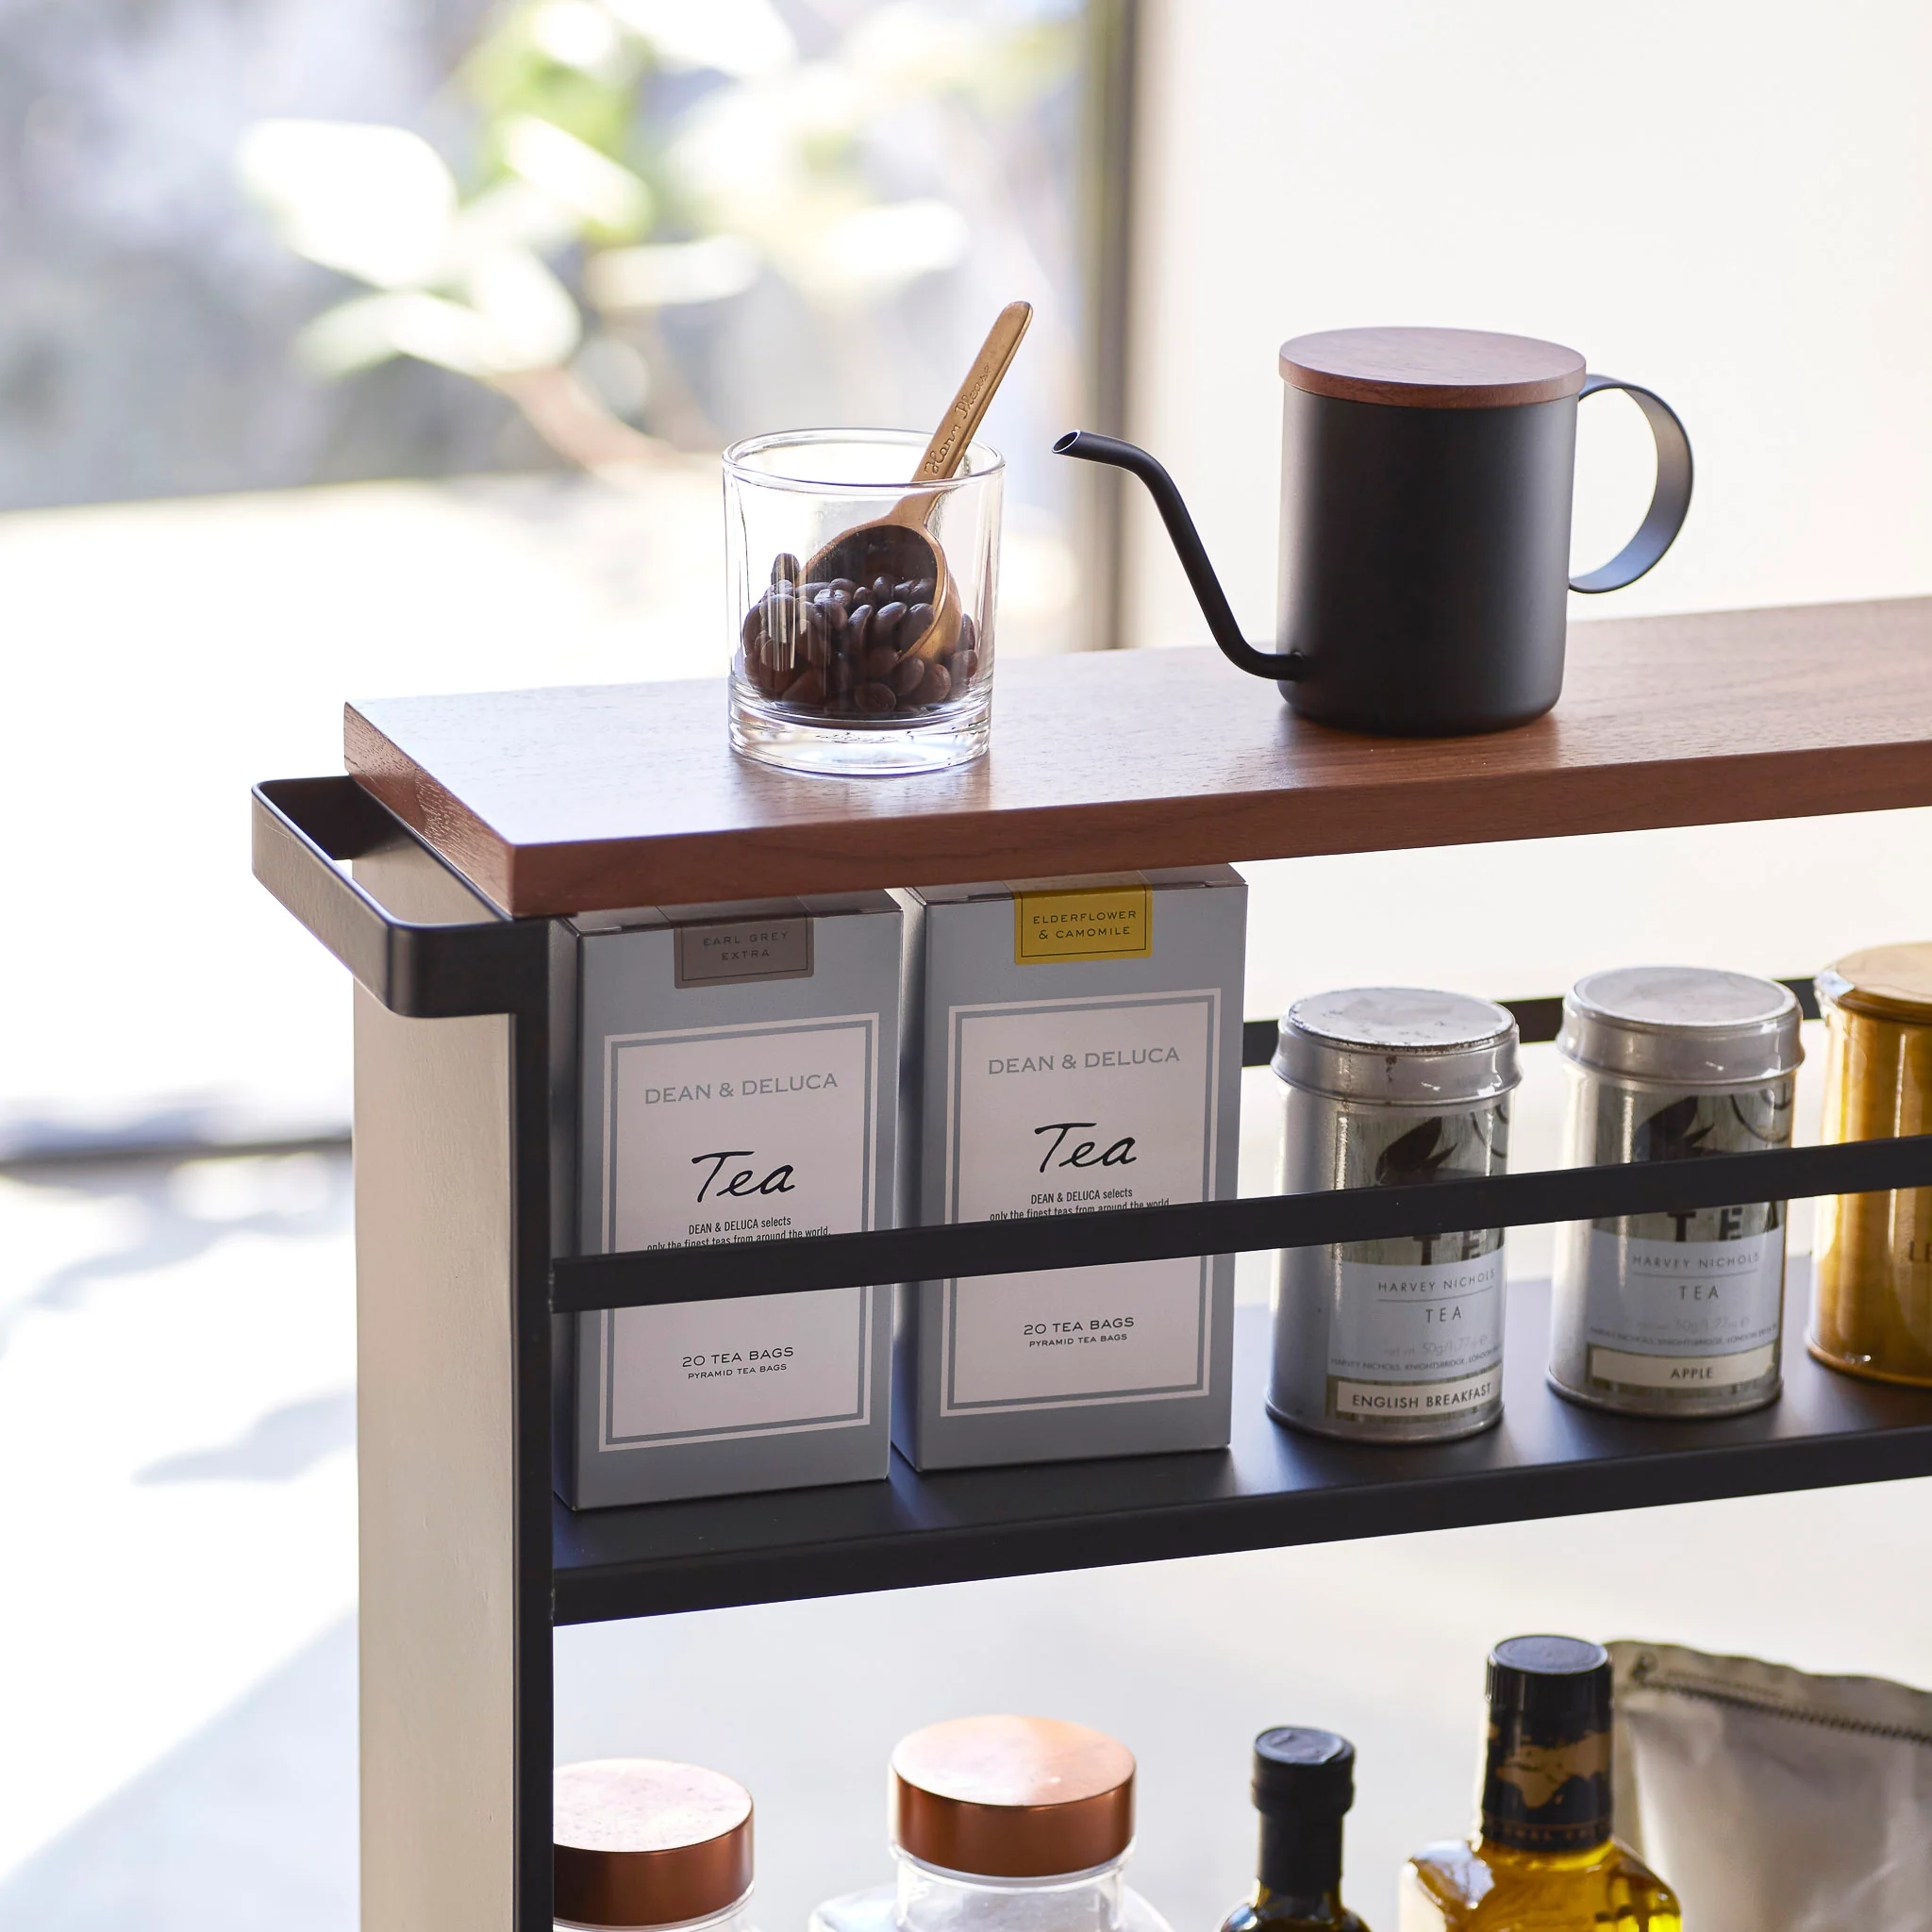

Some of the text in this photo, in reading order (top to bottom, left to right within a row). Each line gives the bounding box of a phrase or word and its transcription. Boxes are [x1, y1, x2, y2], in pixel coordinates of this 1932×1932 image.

[924, 425, 961, 475] Horn
[1033, 910, 1137, 924] ELDERFLOWER
[703, 931, 789, 947] EARL GREY
[1039, 926, 1130, 940] & CAMOMILE
[722, 949, 770, 960] EXTRA
[989, 1047, 1180, 1075] DEAN & DELUCA
[645, 1073, 839, 1105] DEAN & DELUCA
[1034, 1123, 1138, 1174] Tea
[691, 1151, 795, 1203] Tea
[1030, 1188, 1133, 1205] DEAN & DELUCA selects
[1010, 1208, 1024, 1220] the
[1026, 1208, 1051, 1218] finest
[1054, 1207, 1073, 1215] teas
[1075, 1205, 1095, 1213] from
[1098, 1201, 1127, 1212] around
[689, 1216, 791, 1235] DEAN & DELUCA selects
[668, 1240, 682, 1249] the
[684, 1238, 709, 1248] finest
[712, 1236, 731, 1245] teas
[734, 1234, 754, 1244] from
[756, 1230, 786, 1242] around
[789, 1228, 803, 1239] the
[1633, 1253, 1759, 1269] HARVEY NICHOLS
[1378, 1269, 1495, 1292] HARVEY NICHOLS
[1679, 1285, 1719, 1301] TEA
[1425, 1307, 1462, 1324] TEA
[1024, 1317, 1134, 1335] 20 TEA BAGS
[1029, 1339, 1074, 1347] PYRAMID
[1100, 1334, 1127, 1342] BAGS
[682, 1347, 793, 1367] 20 TEA BAGS
[688, 1370, 733, 1379] PYRAMID
[759, 1364, 787, 1373] BAGS
[1670, 1368, 1714, 1379] APPLE
[1353, 1382, 1492, 1408] ENGLISH BREAKFAST
